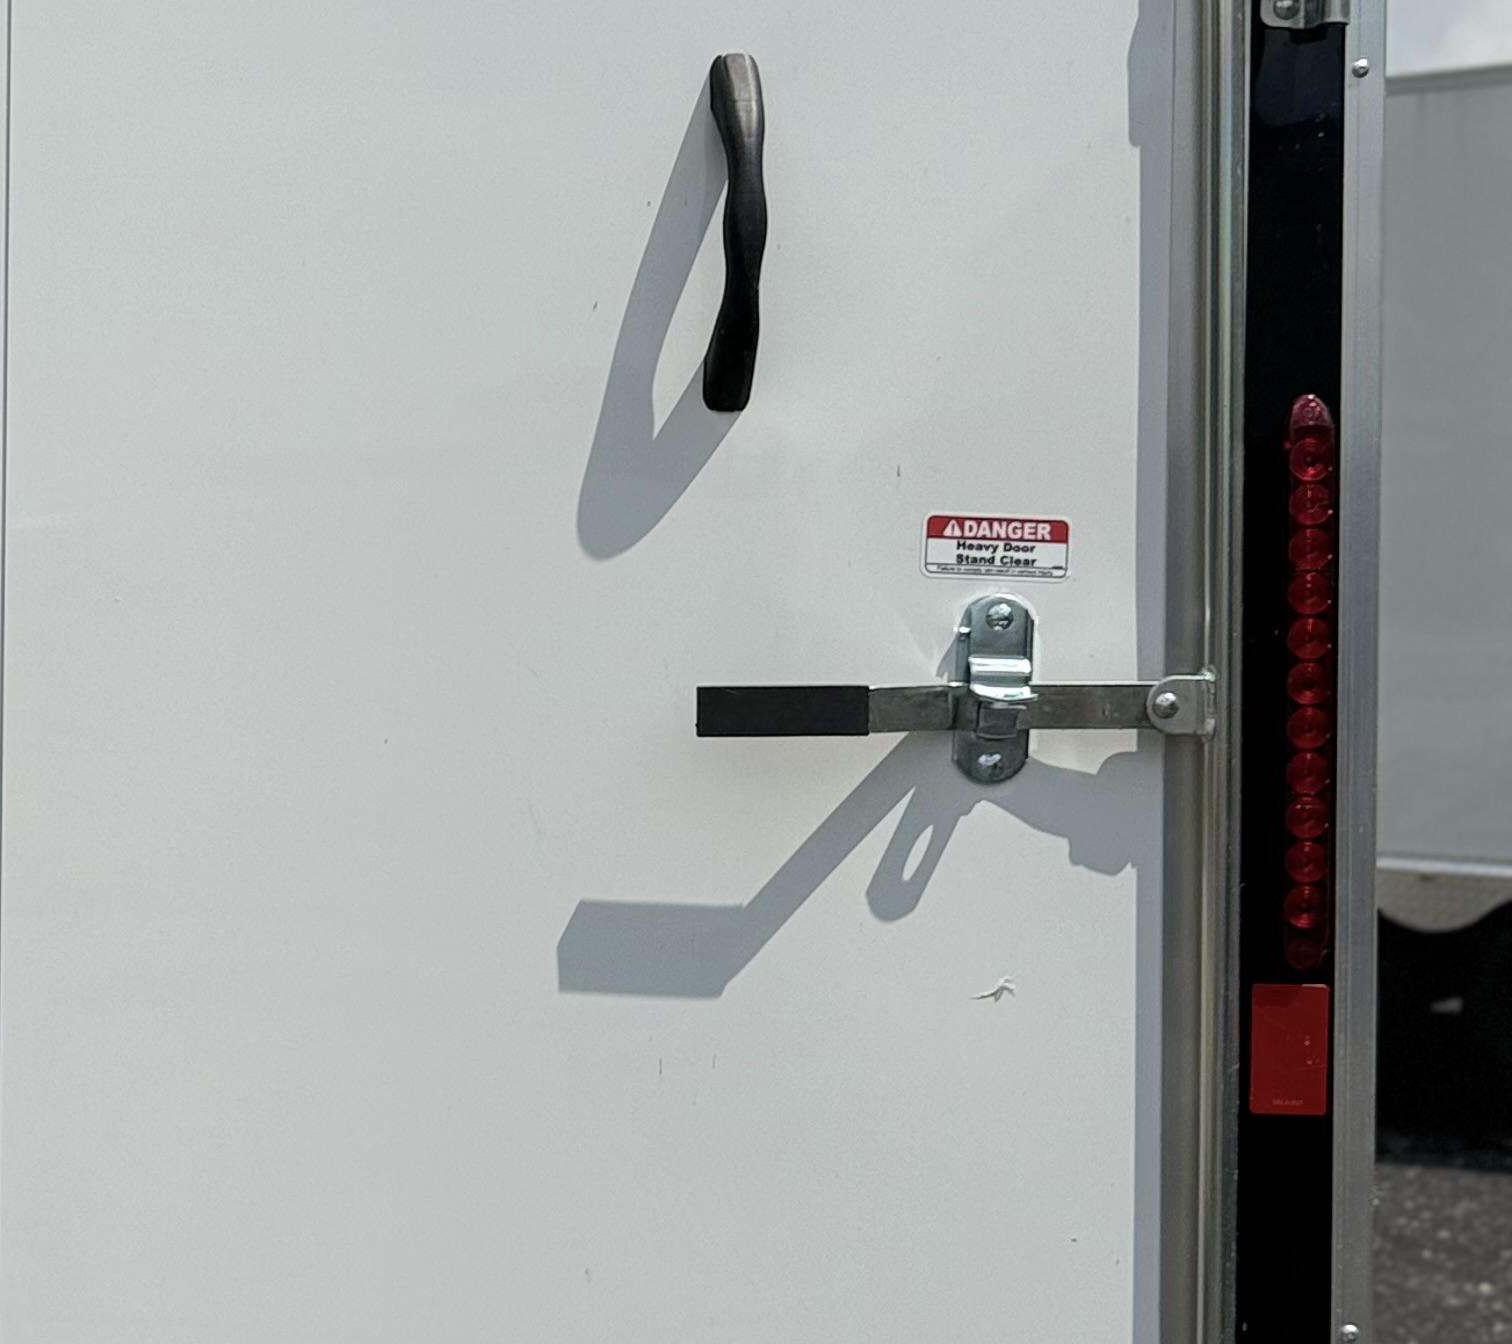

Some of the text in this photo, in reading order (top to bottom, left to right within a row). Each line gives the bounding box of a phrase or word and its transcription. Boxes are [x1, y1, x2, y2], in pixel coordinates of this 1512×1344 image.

[963, 519, 1051, 540] DANGER
[956, 541, 1036, 554] Heavy Door
[955, 554, 1037, 567] Stand Clear
